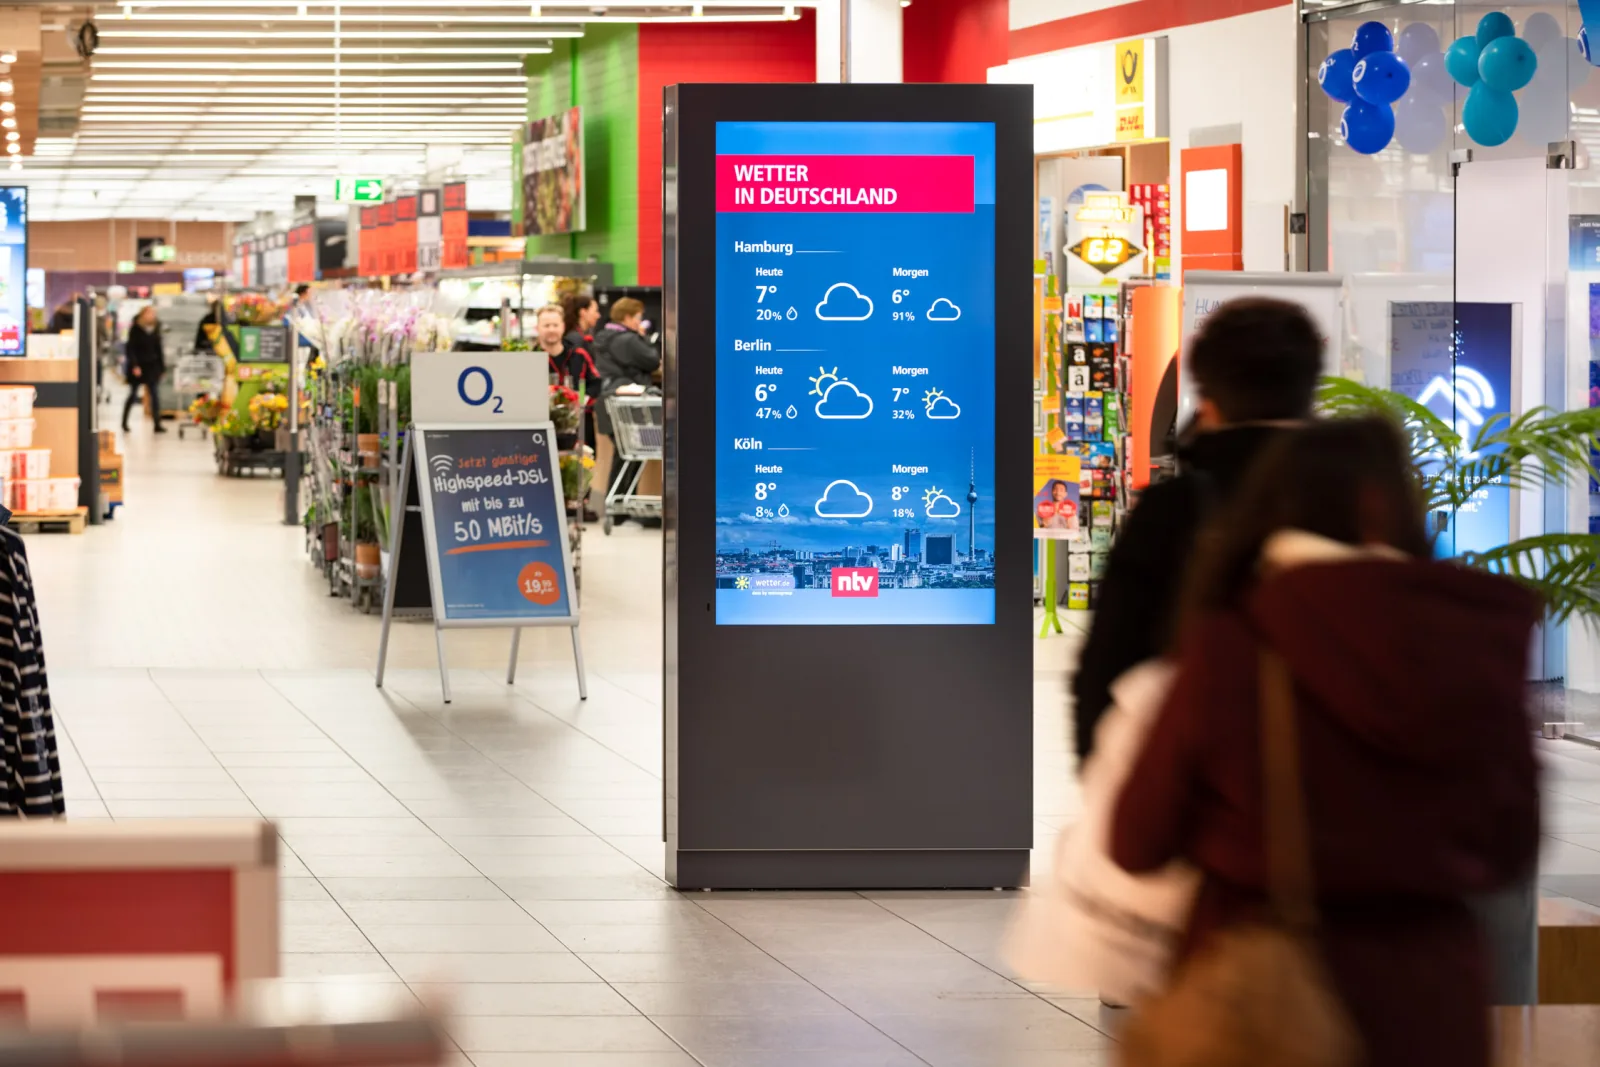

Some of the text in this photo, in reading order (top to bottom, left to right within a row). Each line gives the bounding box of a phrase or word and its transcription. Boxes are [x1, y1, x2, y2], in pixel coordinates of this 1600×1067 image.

[734, 164, 809, 182] WETTER
[735, 187, 898, 205] IN DEUTSCHLAND
[734, 240, 794, 256] Hamburg
[1087, 239, 1123, 264] 62
[755, 267, 784, 277] Heute
[892, 267, 929, 279] Morgen
[755, 285, 778, 304] 7°
[891, 289, 910, 304] 6°
[756, 308, 783, 321] 20%
[892, 311, 916, 321] 91%
[734, 339, 772, 351] Berlin
[755, 365, 784, 375] Heute
[892, 365, 929, 377] Morgen
[1074, 373, 1085, 387] a
[457, 366, 504, 414] O2
[754, 383, 777, 402] 6°
[891, 387, 910, 402] 7°
[755, 407, 782, 419] 47%
[892, 409, 915, 420] 32%
[531, 433, 546, 446] O2
[734, 437, 763, 450] Köln
[457, 453, 540, 469] Jetzt günstiger
[755, 464, 783, 474] Heute
[892, 464, 929, 476] Morgen
[433, 468, 549, 494] Highspeed-DSL
[754, 482, 777, 501] 8°
[891, 486, 910, 501] 8°
[461, 496, 525, 513] mit bis zu
[755, 506, 774, 518] 8%
[892, 508, 915, 518] 18%
[454, 512, 543, 542] 50 MBit/s
[755, 579, 791, 587] wetter.de
[837, 571, 874, 592] ntv
